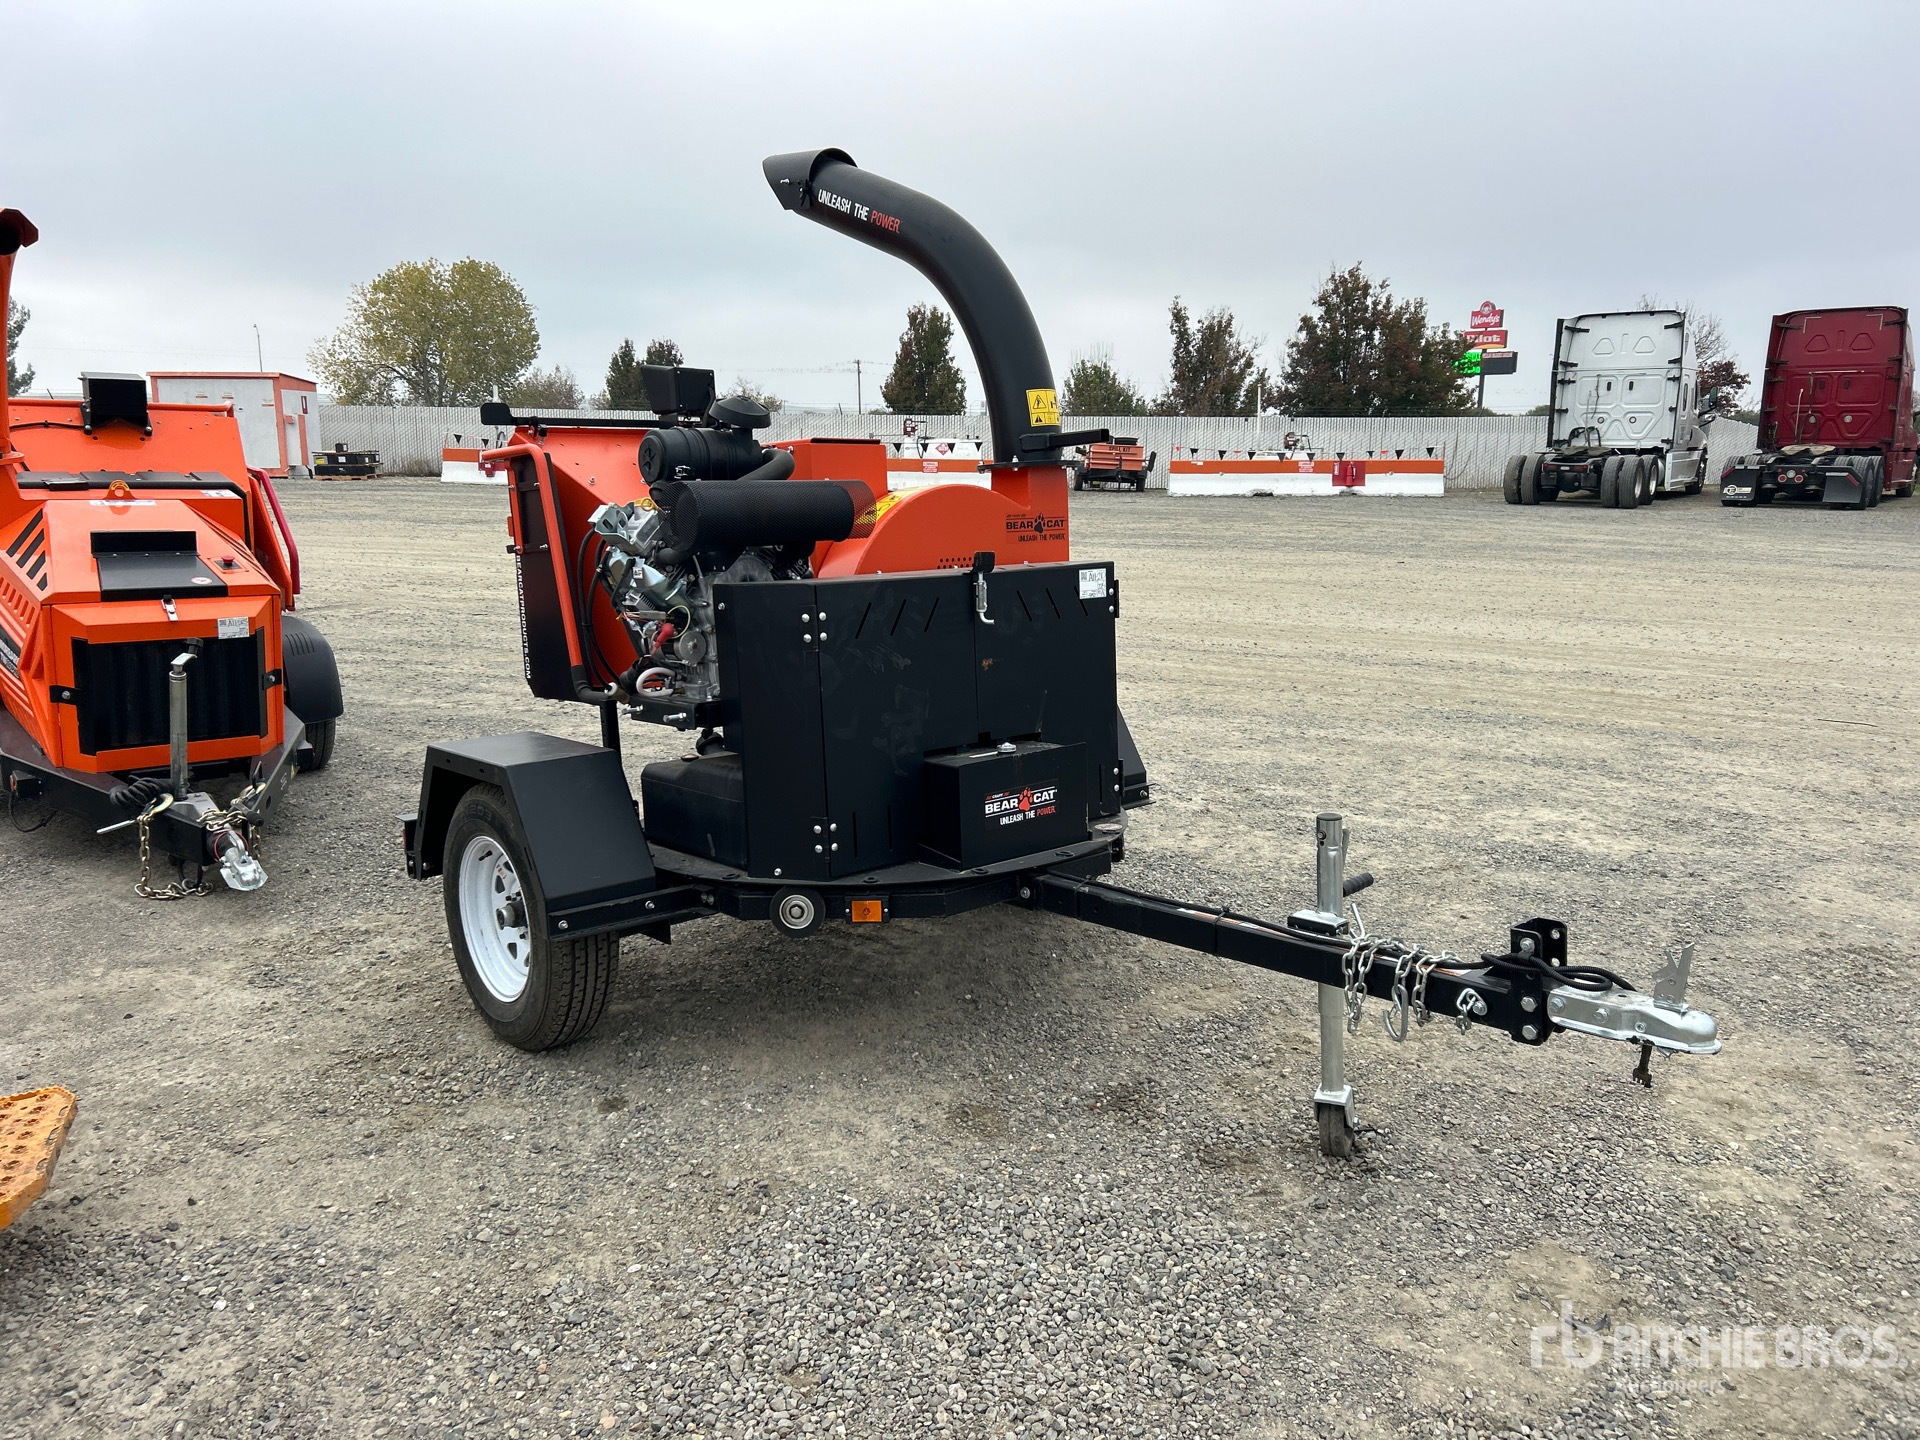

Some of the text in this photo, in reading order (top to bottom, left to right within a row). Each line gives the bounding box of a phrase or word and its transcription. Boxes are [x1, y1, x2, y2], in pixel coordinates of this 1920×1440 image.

[818, 189, 851, 214] UNLEASH
[854, 203, 870, 221] THE
[1471, 313, 1500, 327] Wendy's
[1006, 519, 1065, 530] BEAR CAT
[1017, 534, 1038, 542] UNLEASH
[985, 789, 1055, 814] BEAR CAT
[1000, 813, 1024, 825] UNLEASH
[1025, 810, 1036, 819] THE
